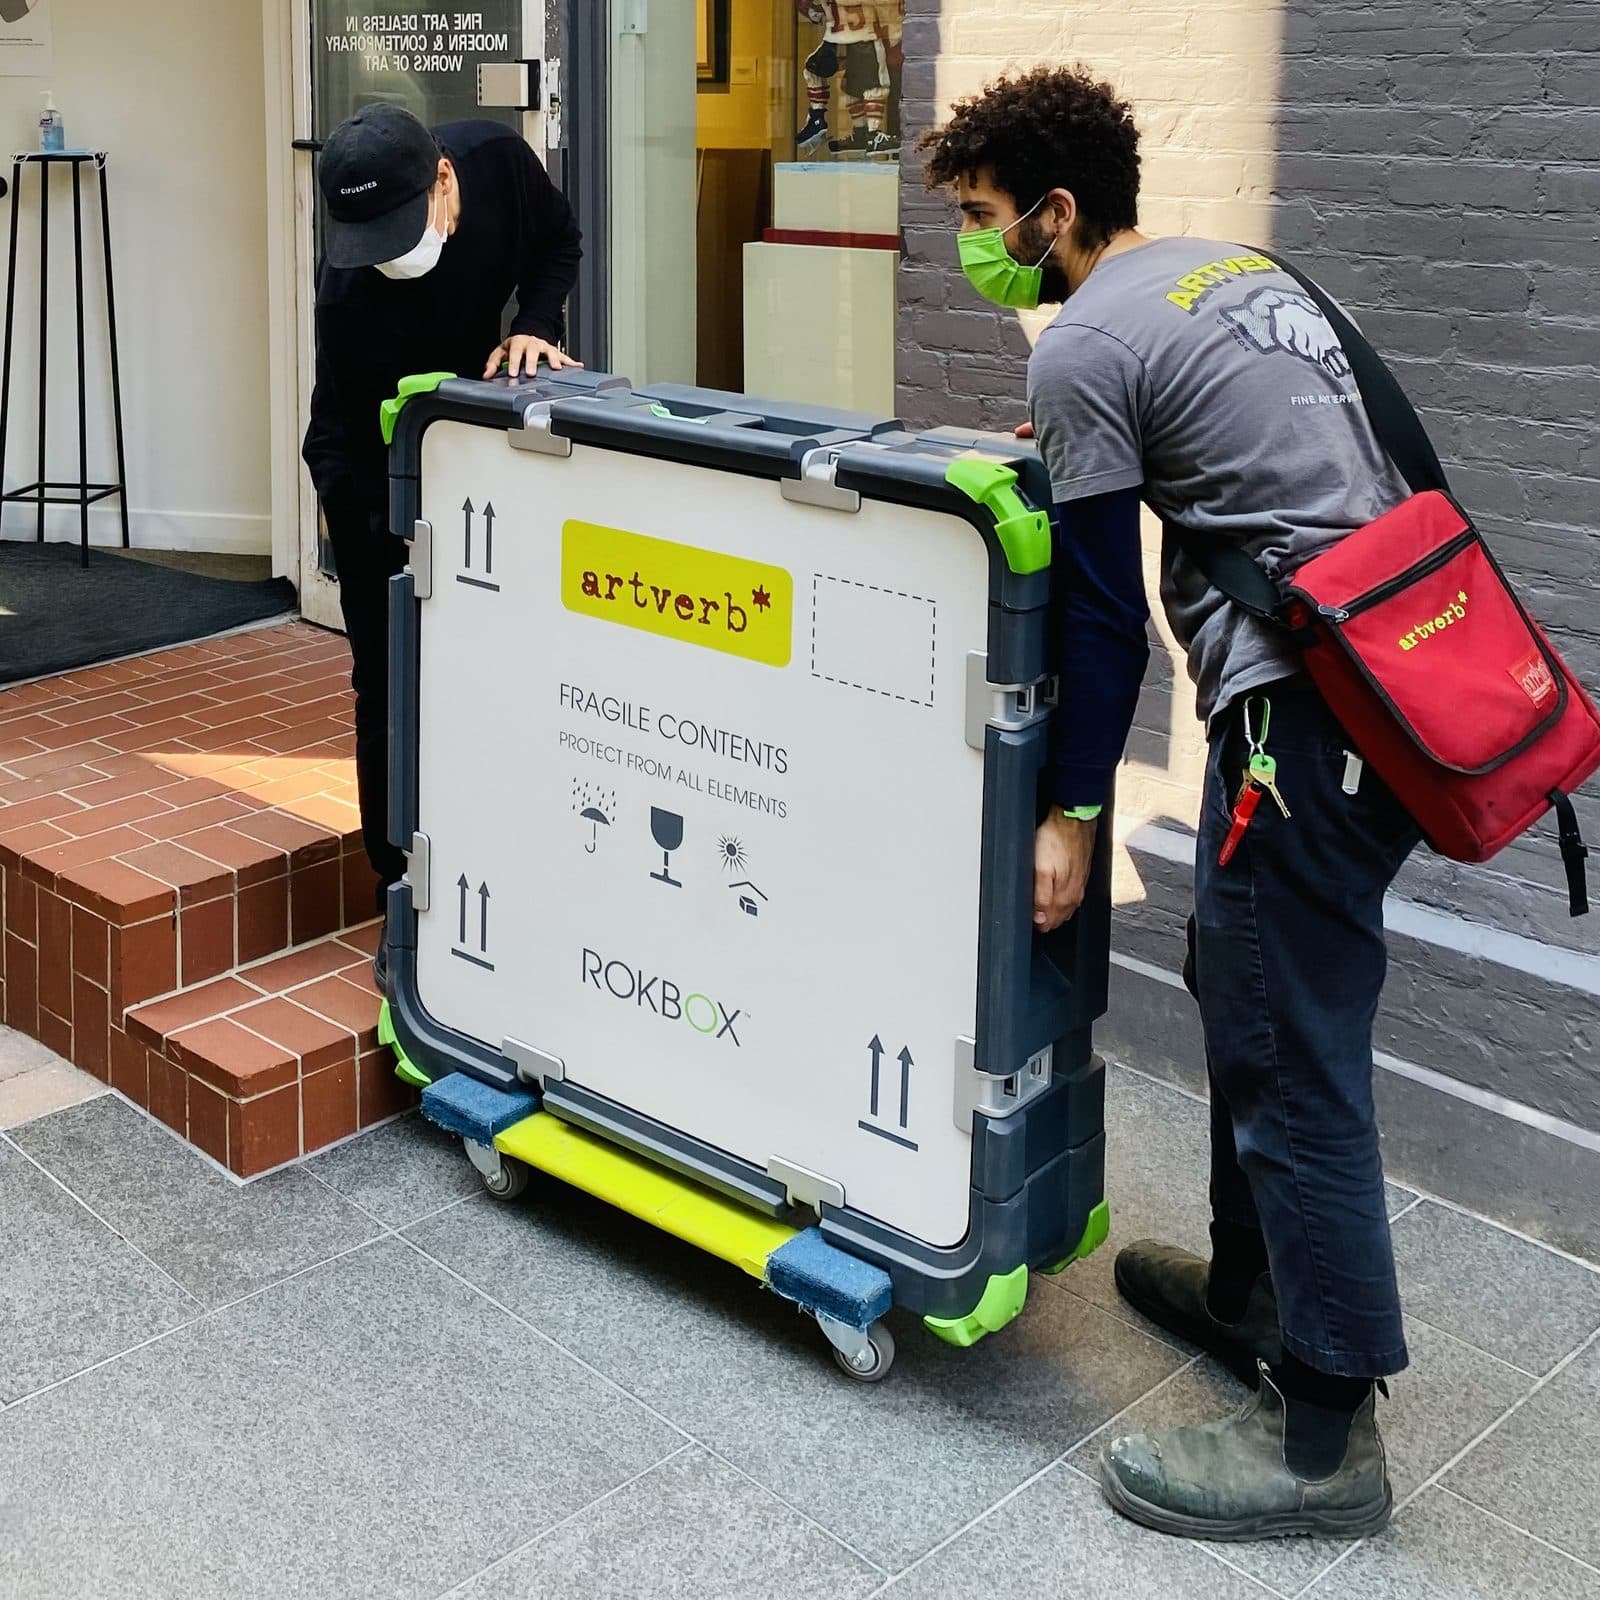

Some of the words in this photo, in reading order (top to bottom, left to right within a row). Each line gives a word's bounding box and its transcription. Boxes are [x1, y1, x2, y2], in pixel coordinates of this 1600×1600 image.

[1165, 255, 1282, 313] ARTVER
[1291, 395, 1316, 406] FINE
[560, 683, 650, 732] FRAGILE
[658, 714, 788, 774] CONTENTS
[559, 731, 624, 766] PROTECT
[627, 753, 672, 782] FROM
[676, 773, 703, 793] ALL
[708, 779, 788, 819] ELEMENTS
[582, 947, 741, 1047] ROKBOX
